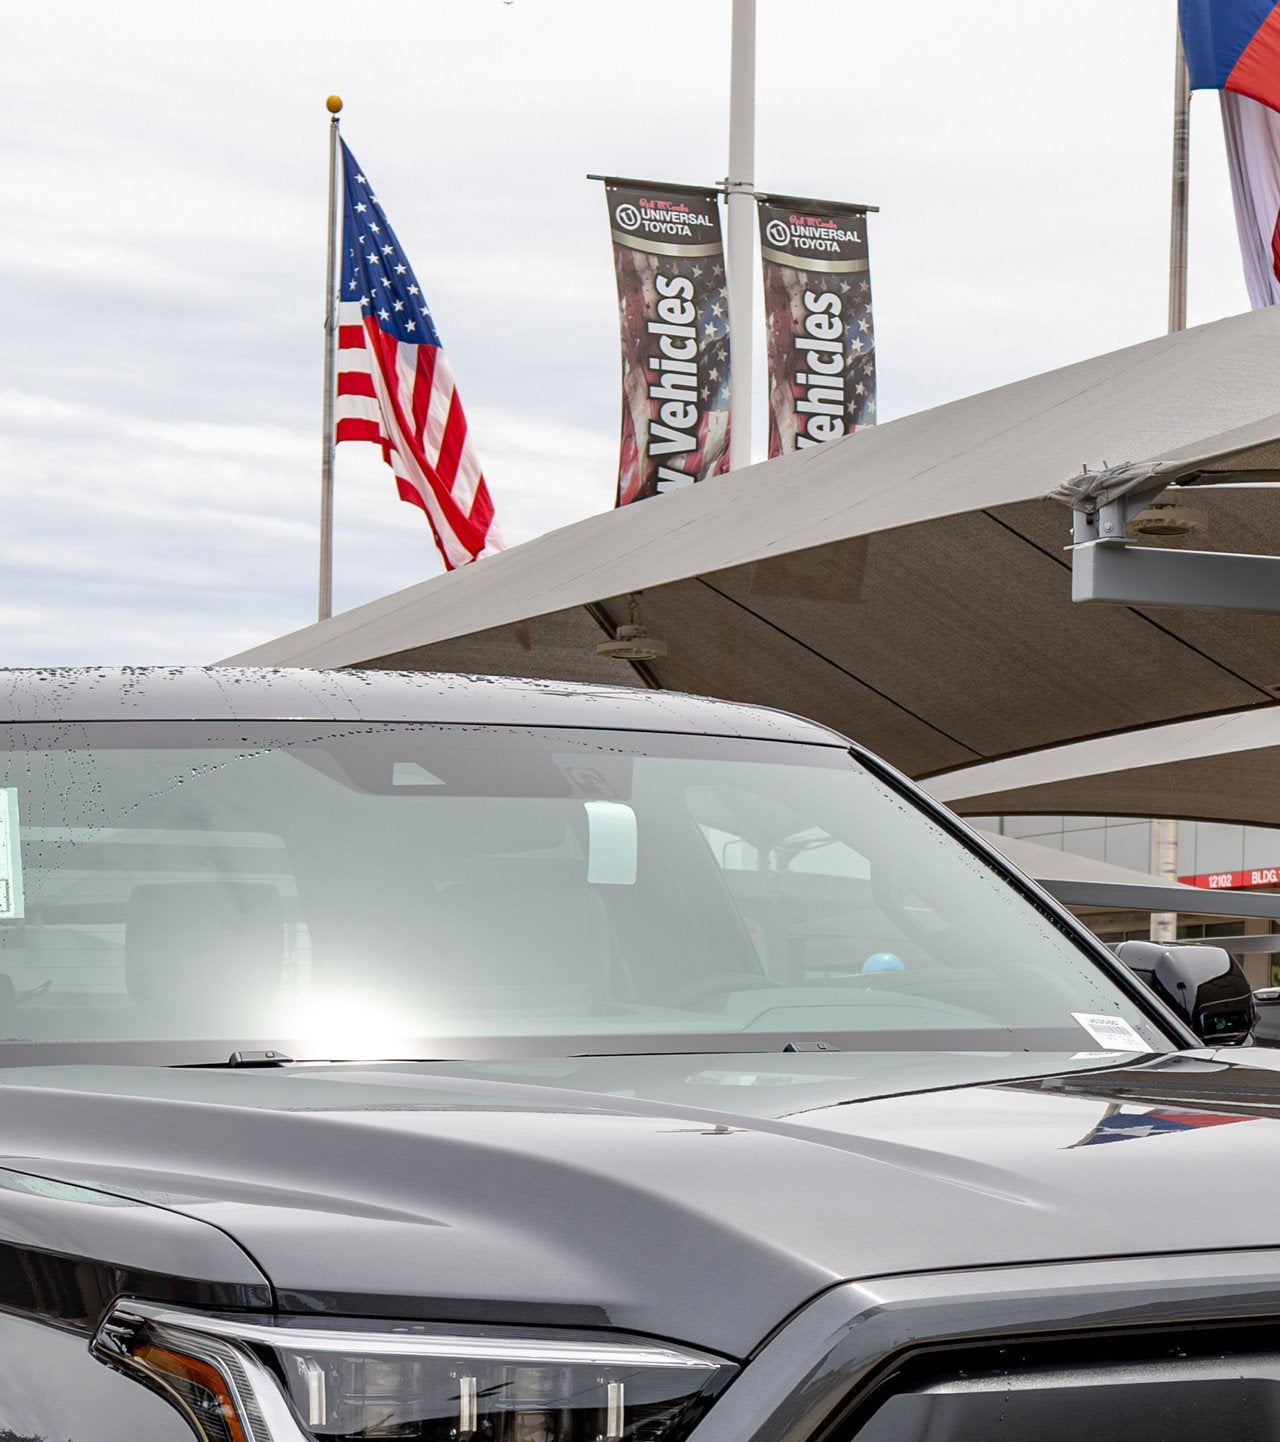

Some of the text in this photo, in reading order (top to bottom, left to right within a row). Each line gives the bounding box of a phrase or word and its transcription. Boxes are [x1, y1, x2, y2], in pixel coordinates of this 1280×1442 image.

[640, 208, 714, 227] UNIVERSAL
[641, 220, 692, 236] TOYOTA
[790, 224, 862, 243] UNIVERSAL
[791, 236, 841, 253] TOYOTA
[647, 274, 699, 456] Vehicles
[1208, 874, 1232, 888] 12102
